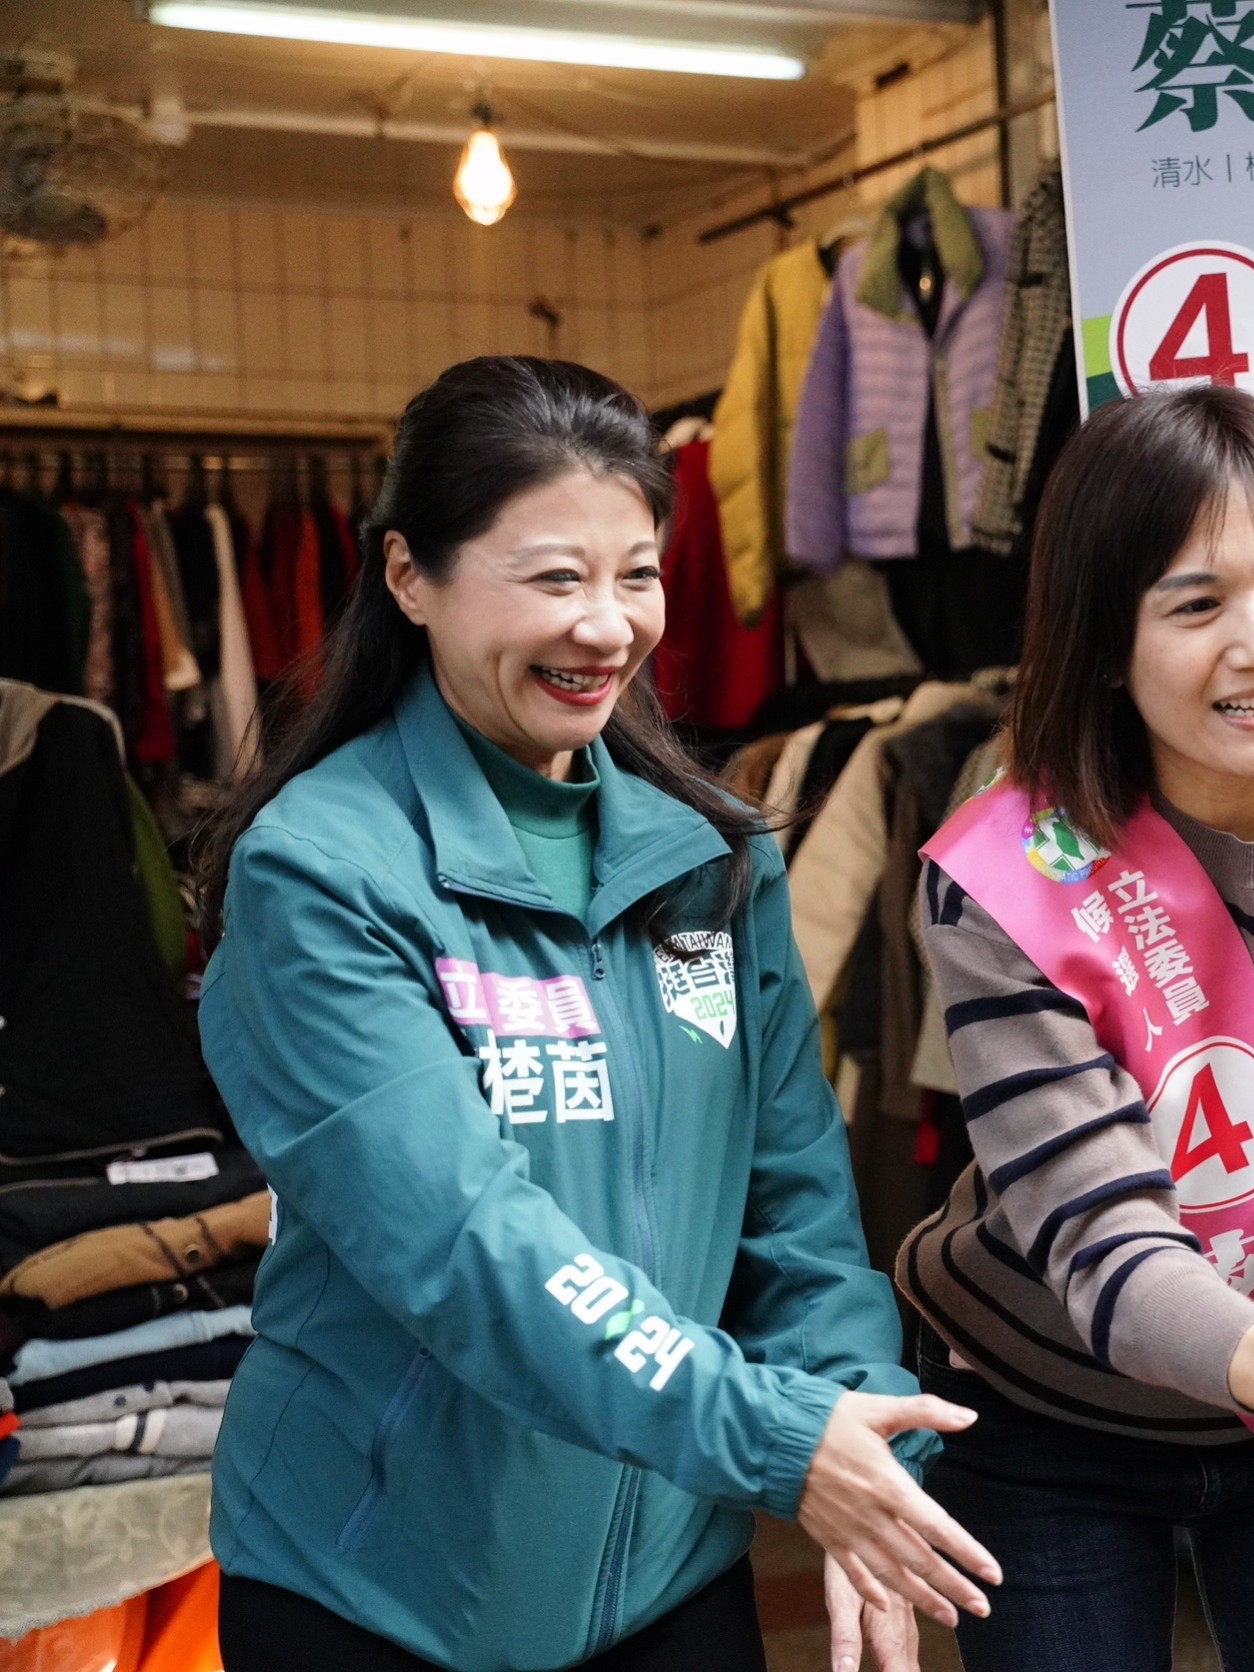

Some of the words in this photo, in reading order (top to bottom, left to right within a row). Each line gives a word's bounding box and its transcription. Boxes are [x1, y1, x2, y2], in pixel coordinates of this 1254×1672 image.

[1149, 272, 1249, 388] 4
[1070, 889, 1164, 1053] 候選人
[1107, 869, 1211, 1027] 立法委員
[1171, 1063, 1254, 1183] 4
